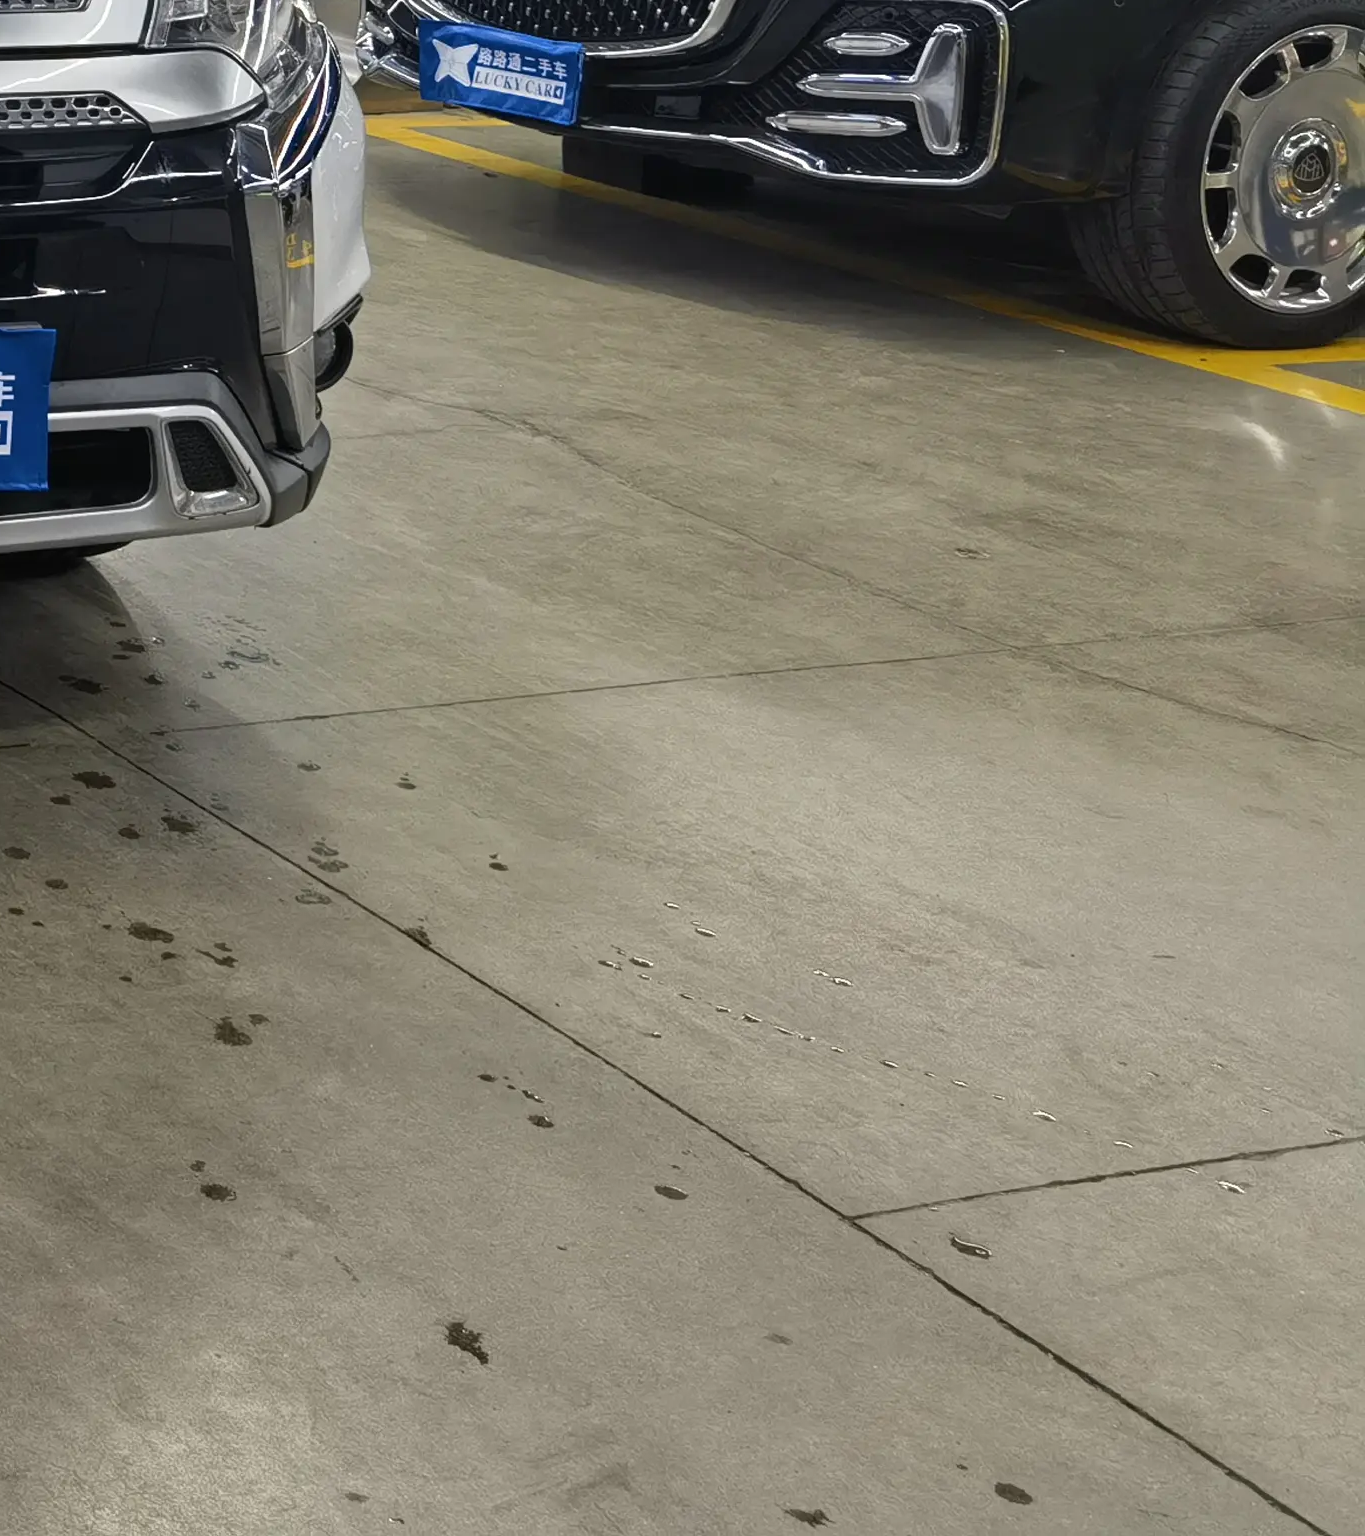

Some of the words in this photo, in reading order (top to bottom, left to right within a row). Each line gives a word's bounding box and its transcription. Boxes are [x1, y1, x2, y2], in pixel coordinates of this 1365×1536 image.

[477, 47, 568, 80] 路路通二手车
[475, 70, 523, 91] LUCKY
[525, 80, 553, 98] CAR
